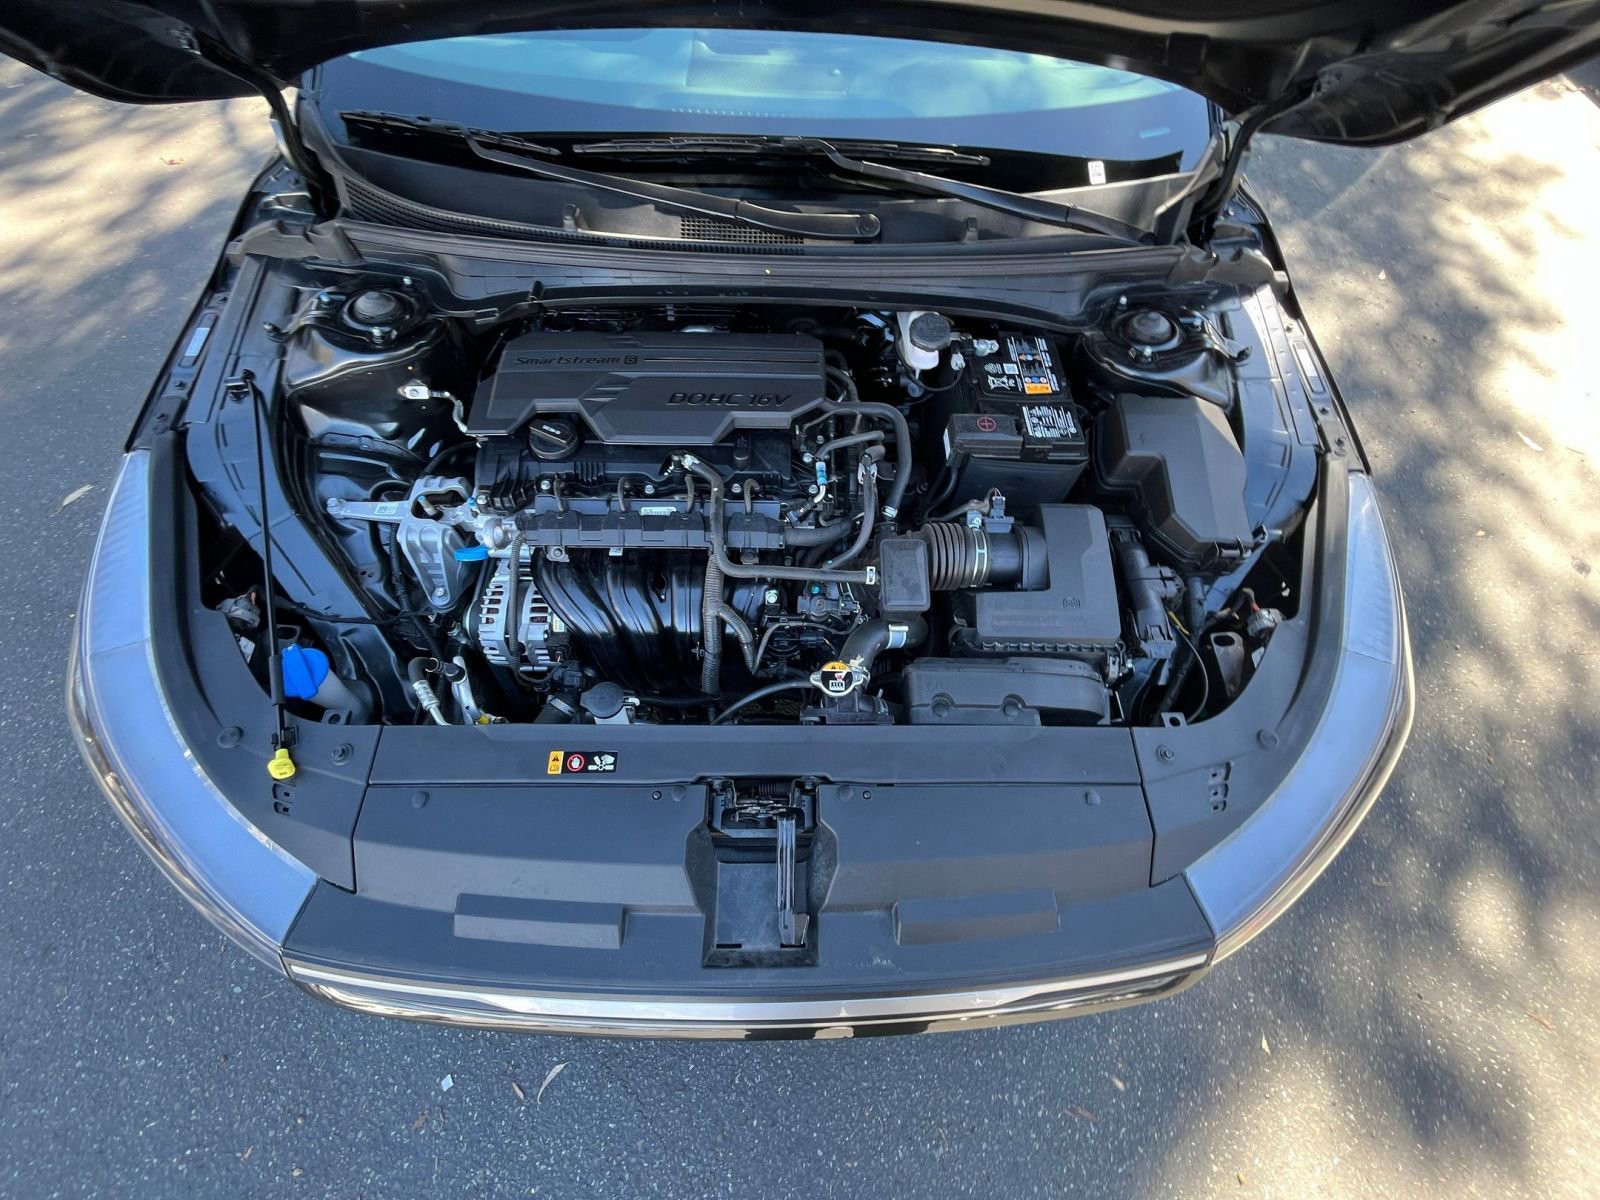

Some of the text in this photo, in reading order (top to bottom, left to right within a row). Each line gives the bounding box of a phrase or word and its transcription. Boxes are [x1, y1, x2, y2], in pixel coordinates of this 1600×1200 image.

[514, 356, 620, 365] Smartstream
[666, 392, 792, 407] DOHC 16V
